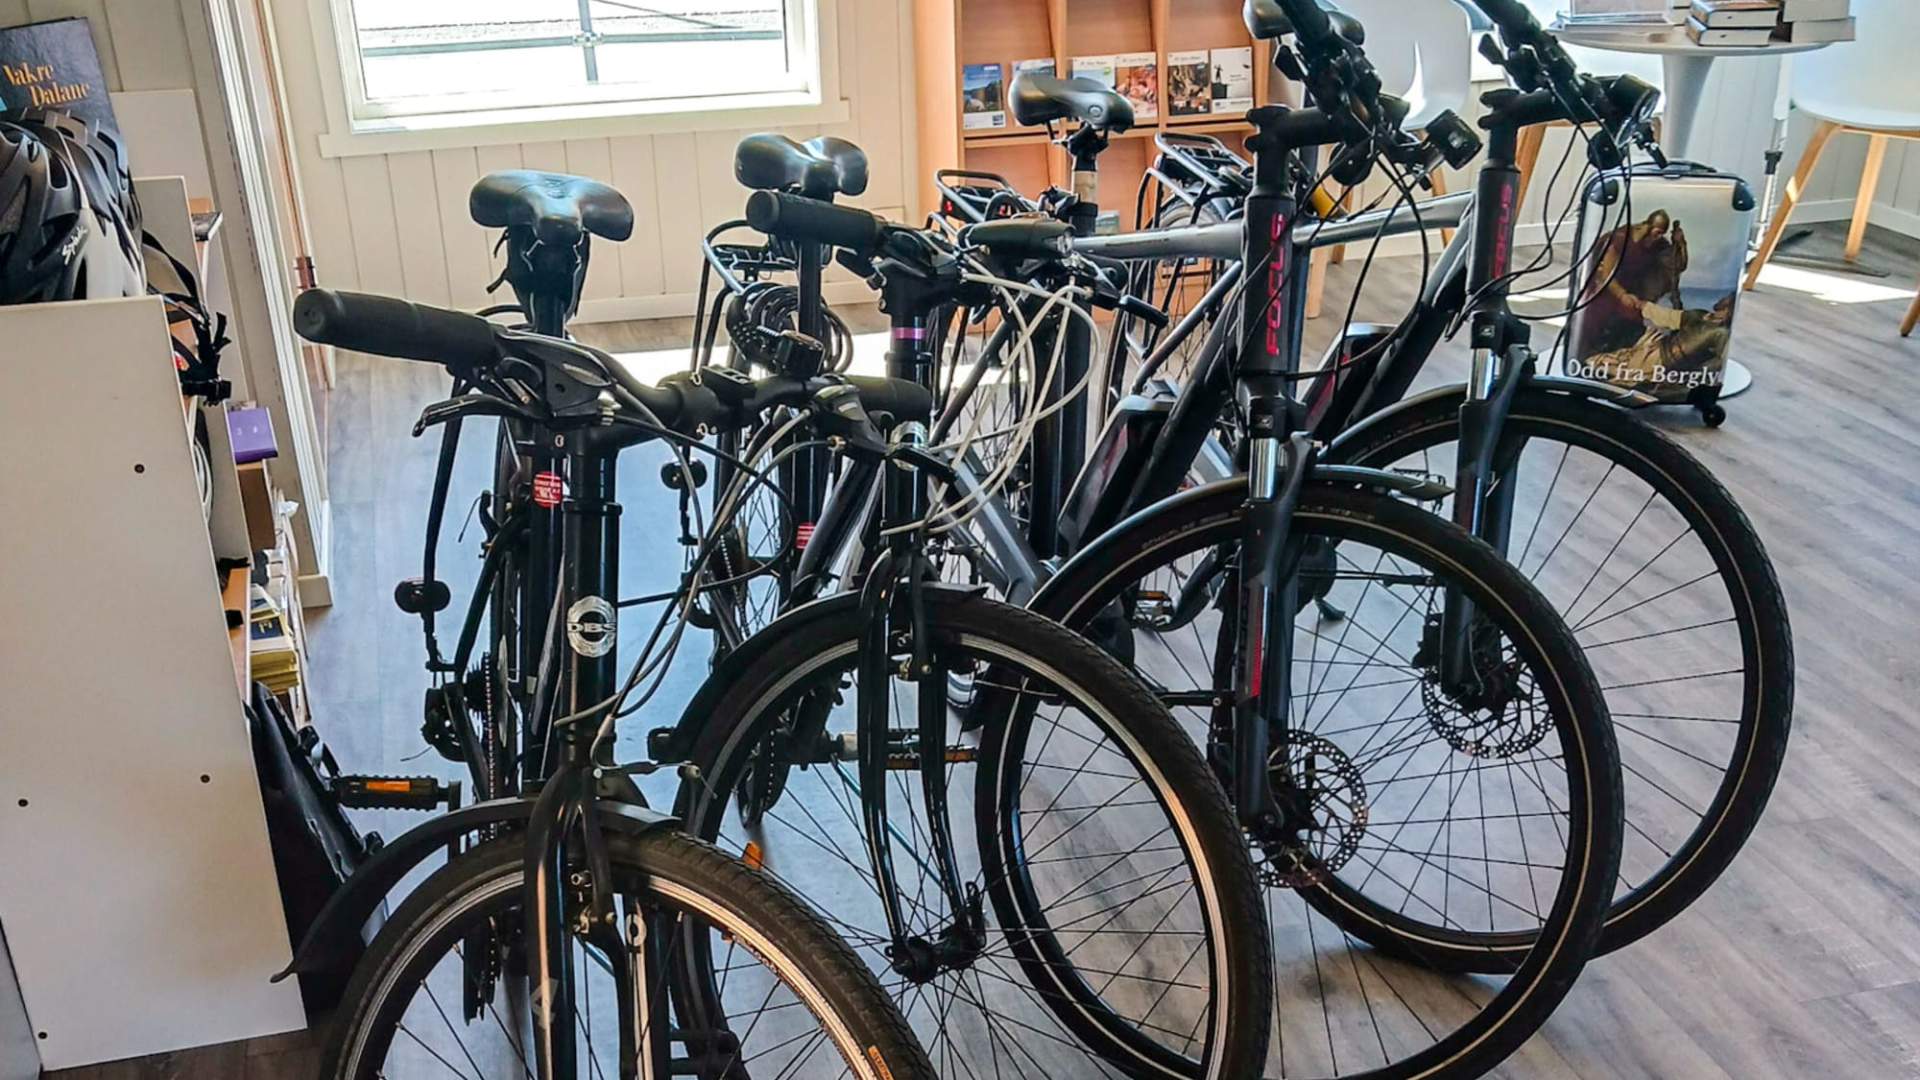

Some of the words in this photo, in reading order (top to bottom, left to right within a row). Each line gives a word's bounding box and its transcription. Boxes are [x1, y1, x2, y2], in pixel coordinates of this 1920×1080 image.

[3, 62, 54, 86] Vakre
[30, 81, 90, 111] Dalane
[1266, 212, 1286, 356] FOCUS
[1567, 358, 1608, 380] Odd
[1615, 362, 1645, 382] fra
